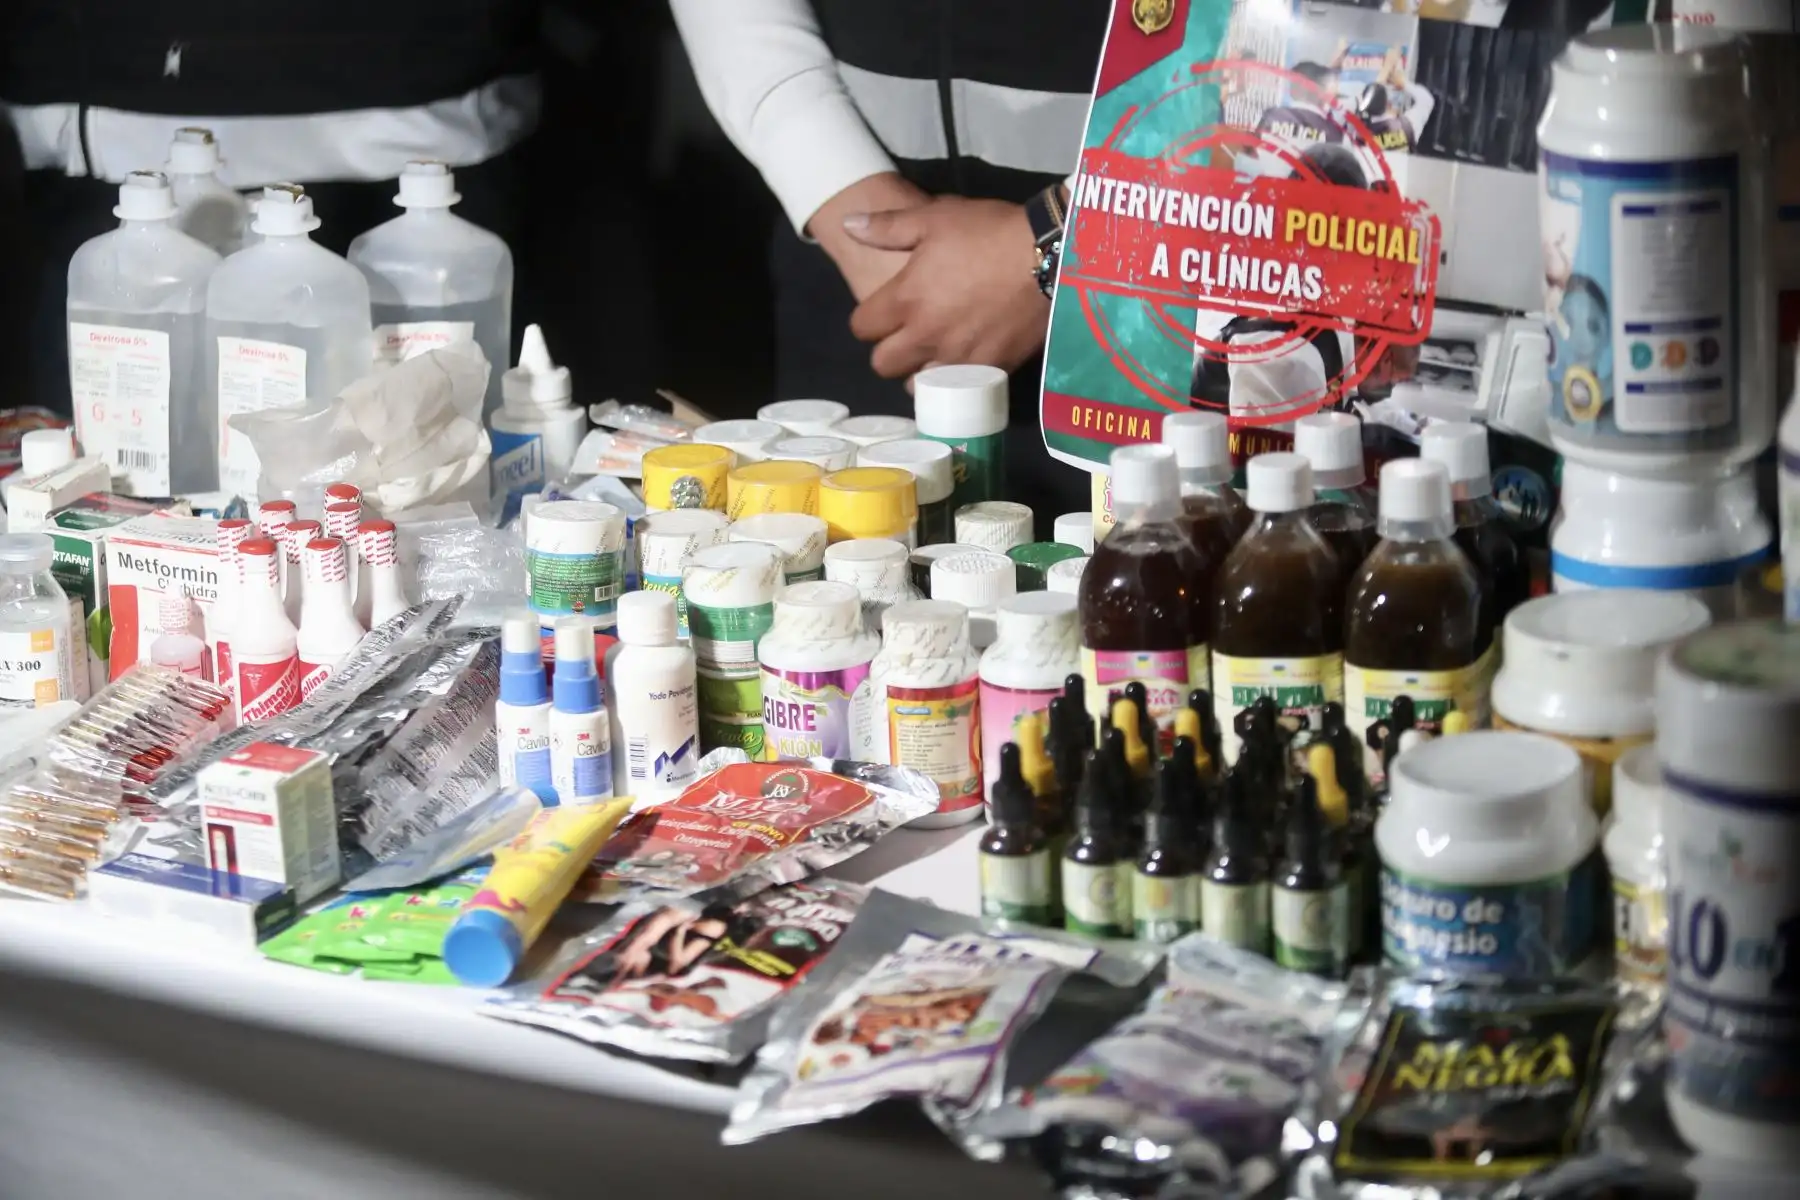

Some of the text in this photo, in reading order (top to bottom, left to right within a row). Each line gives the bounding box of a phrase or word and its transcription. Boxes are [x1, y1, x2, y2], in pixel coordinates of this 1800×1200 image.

[1075, 173, 1421, 265] INTERVENCIÓN POLICIAL
[1150, 243, 1323, 301] A CLÍNICAS
[92, 403, 105, 422] G
[1071, 405, 1152, 440] OFICINA
[118, 552, 218, 585] Metformin
[16, 660, 42, 672] 300
[299, 669, 330, 702] olina
[577, 733, 590, 741] 3M
